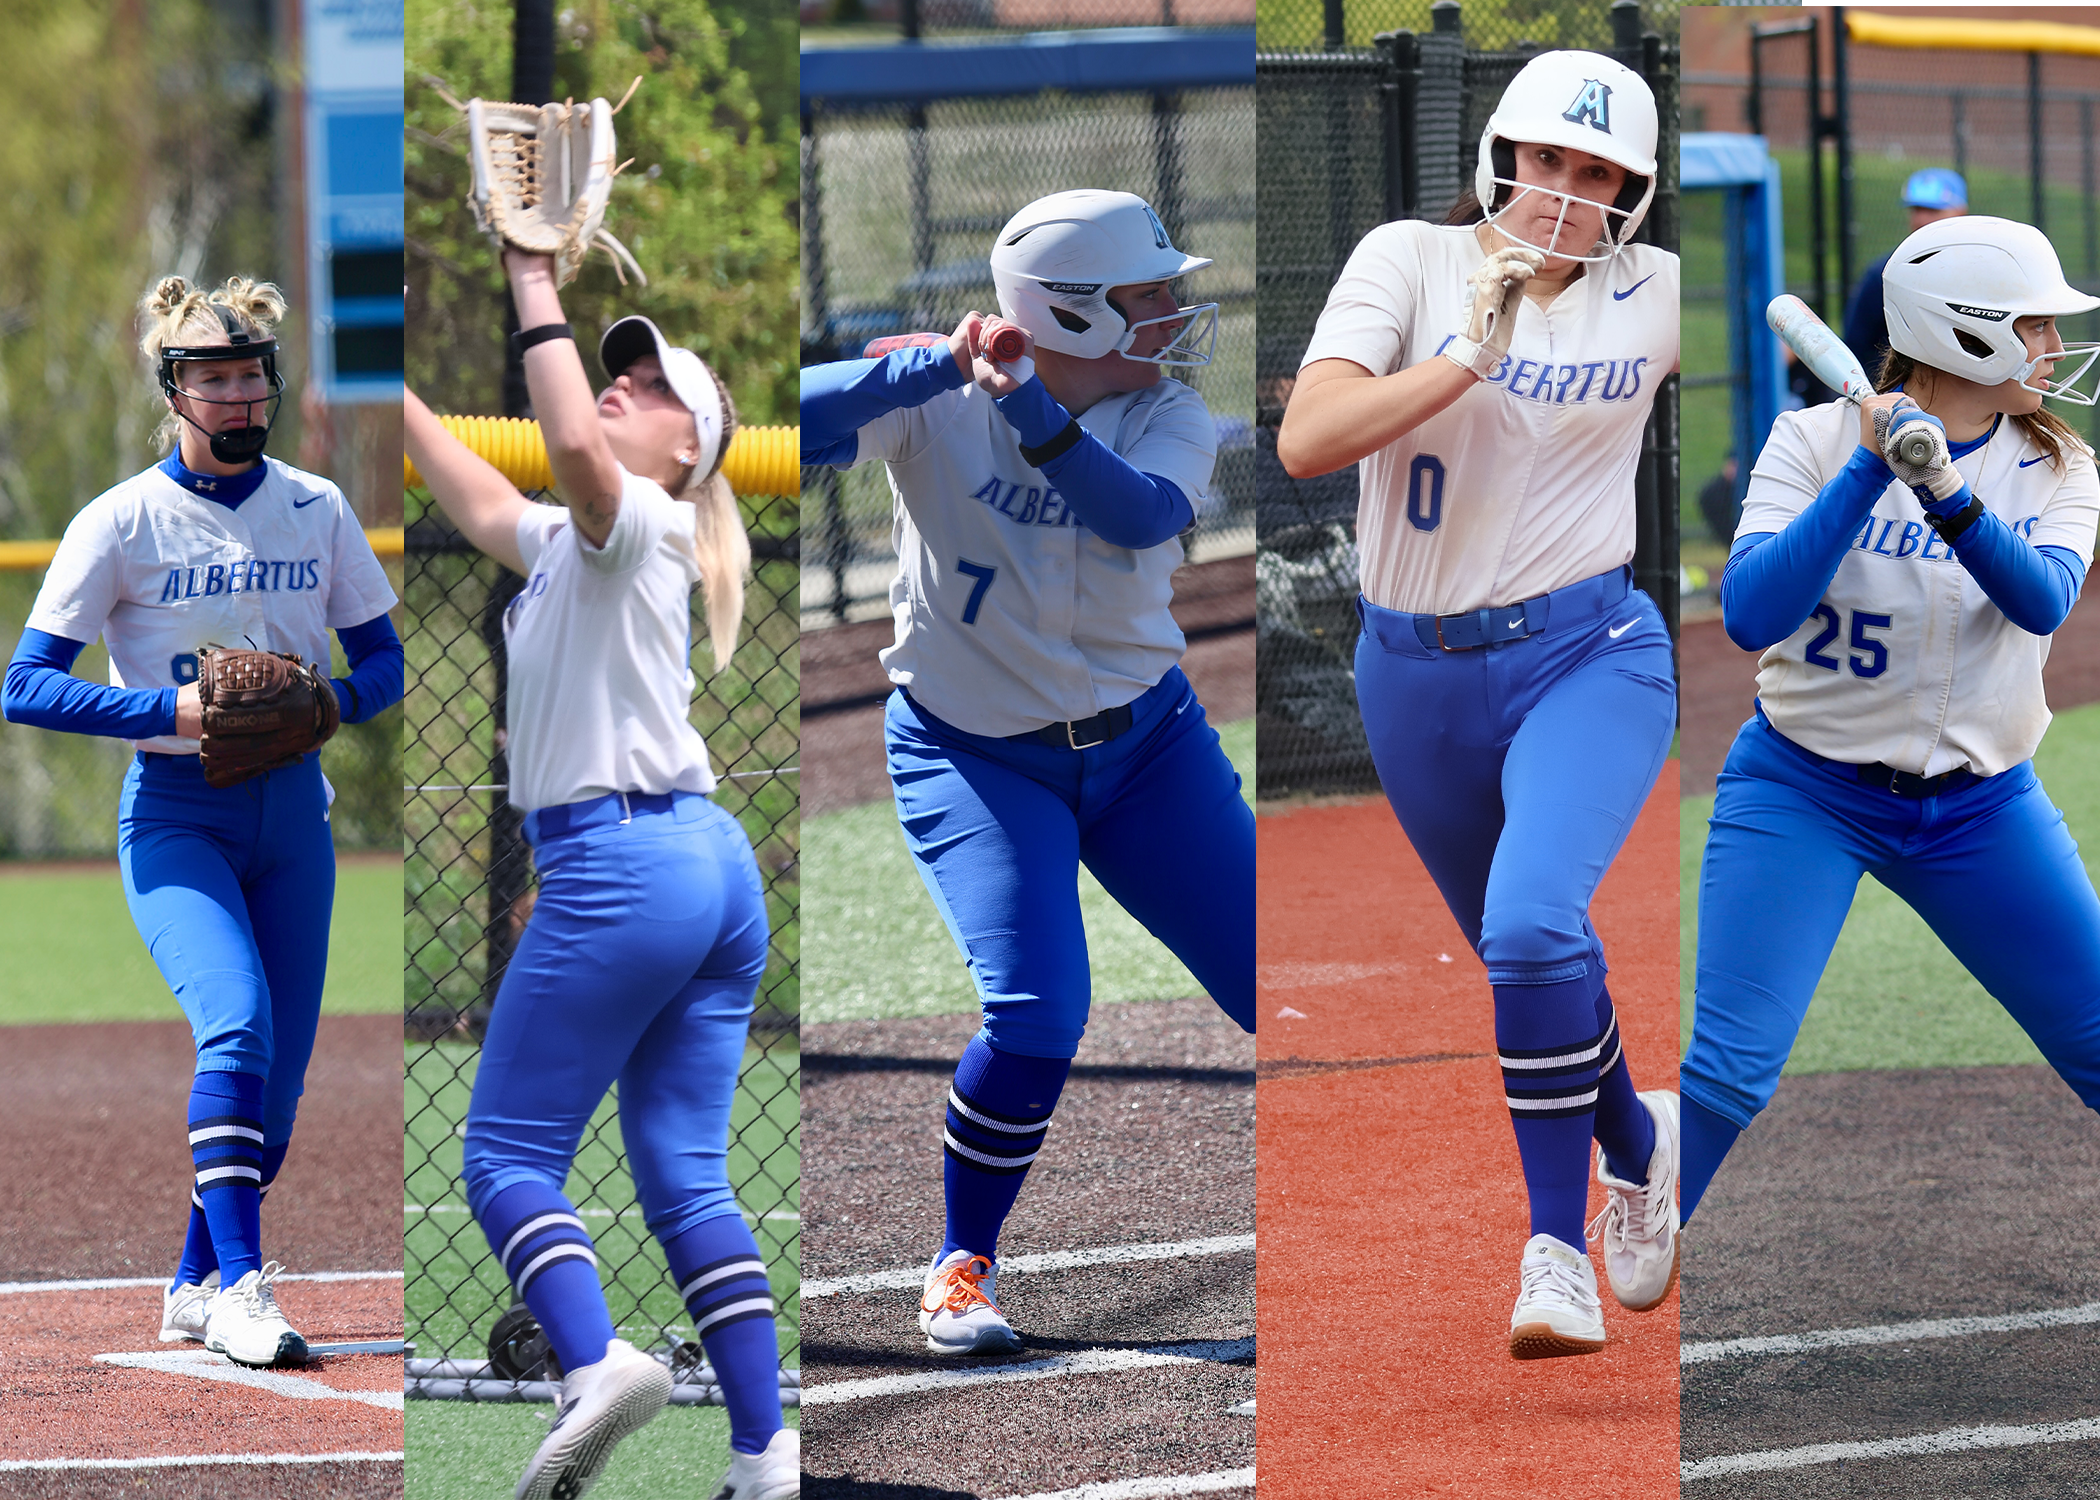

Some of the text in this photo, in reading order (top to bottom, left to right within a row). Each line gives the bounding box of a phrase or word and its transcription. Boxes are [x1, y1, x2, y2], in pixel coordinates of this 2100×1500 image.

[1052, 283, 1095, 292] EASTON
[1959, 306, 2003, 319] EASTON
[1407, 452, 1447, 535] 0
[157, 558, 320, 604] ALBERTUS
[955, 556, 998, 627] 7
[1804, 602, 1893, 680] 25
